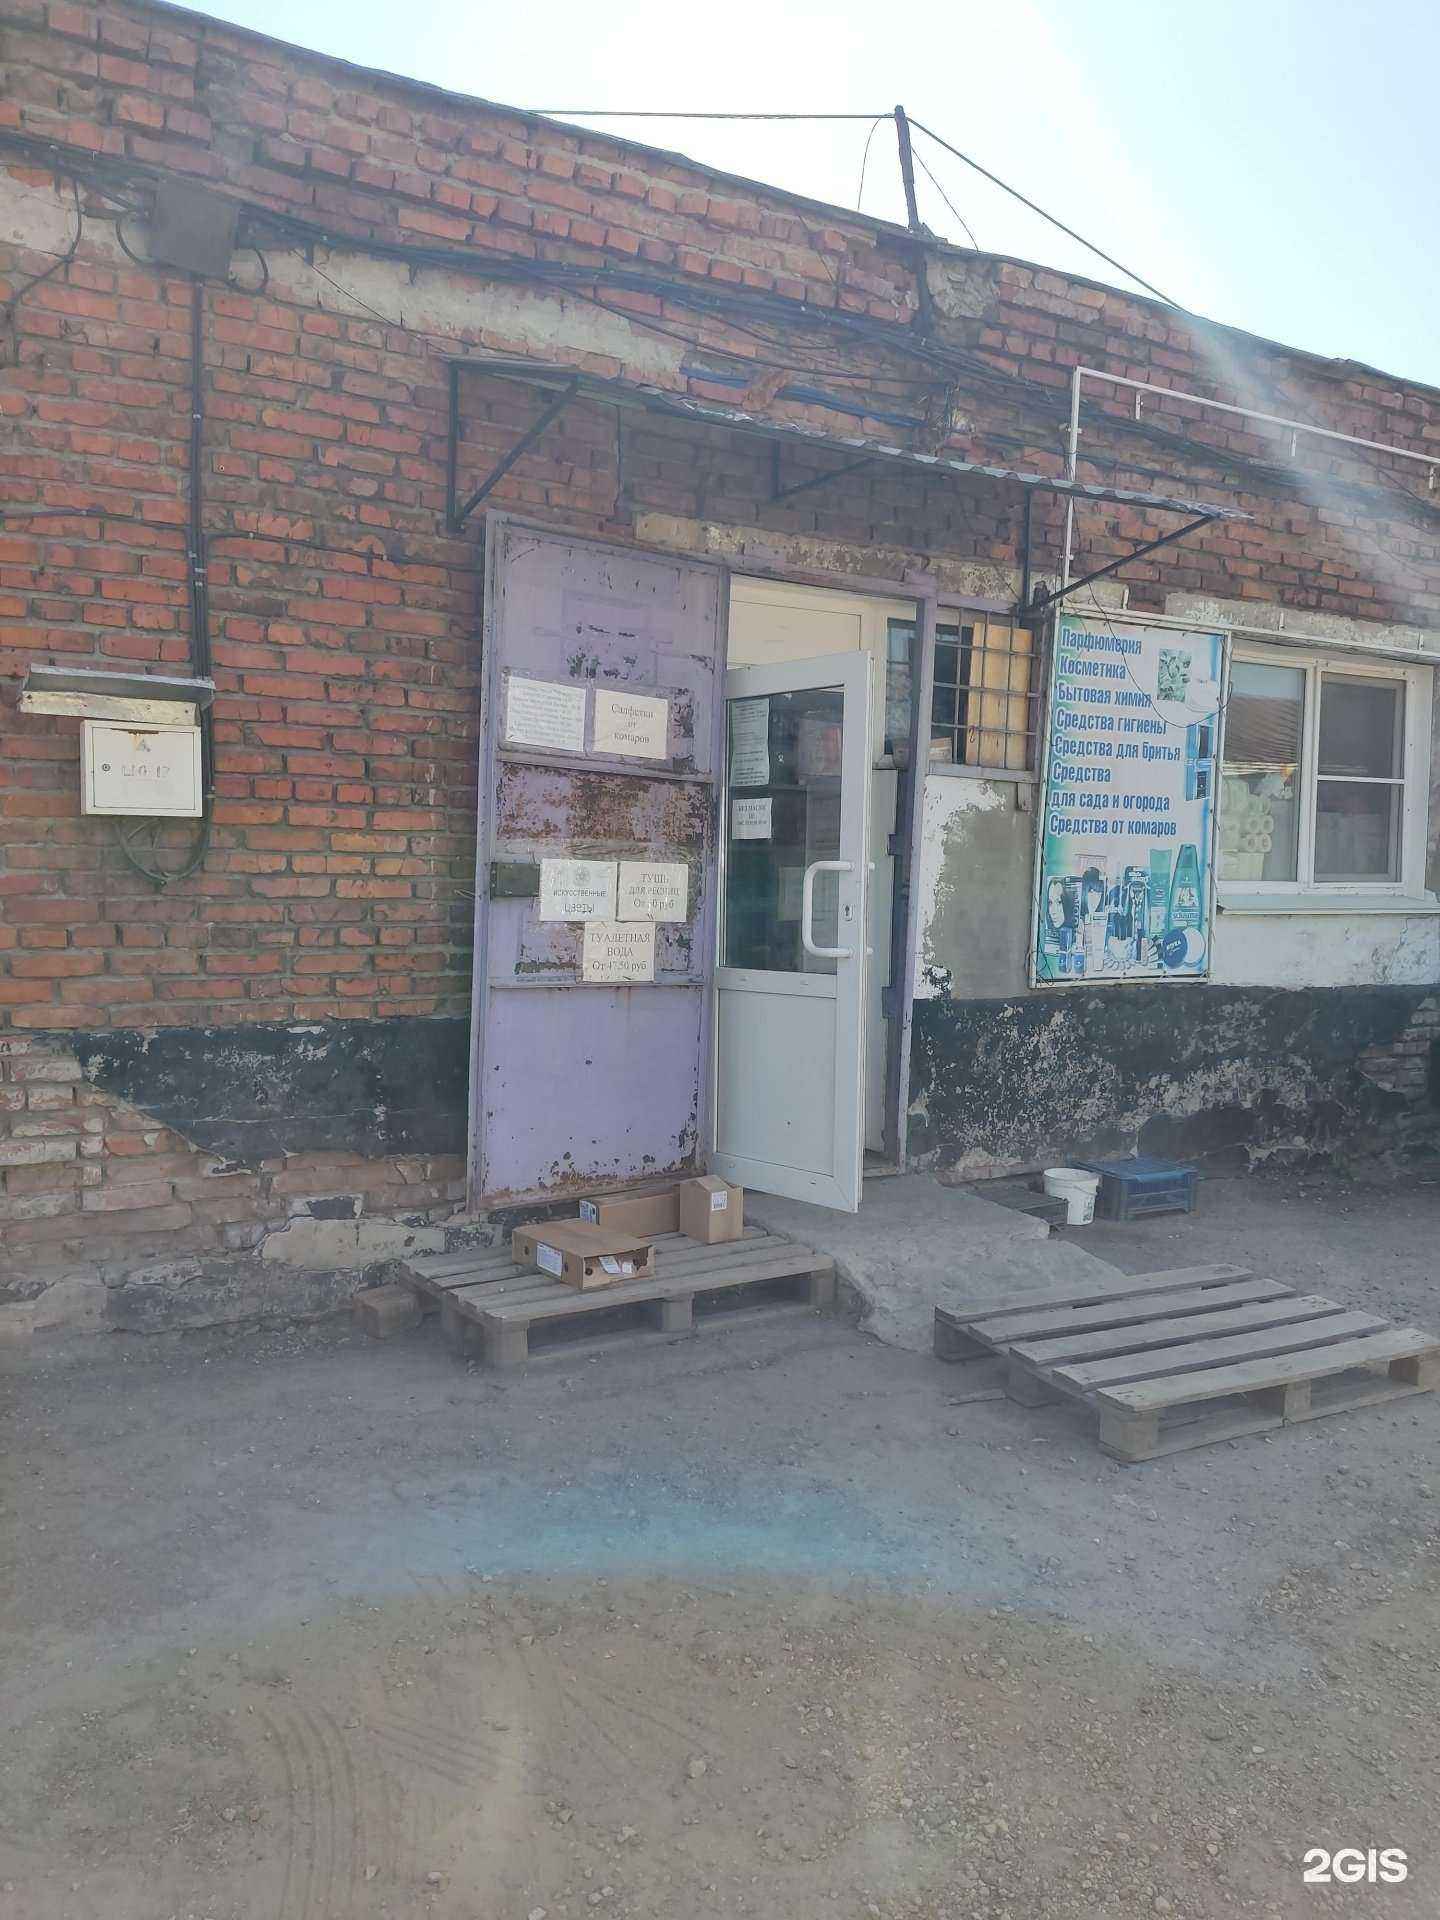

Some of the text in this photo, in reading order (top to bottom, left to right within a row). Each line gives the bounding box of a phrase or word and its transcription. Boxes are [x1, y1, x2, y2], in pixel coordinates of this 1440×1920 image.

[1062, 628, 1142, 655] Парфюмерия
[1060, 656, 1126, 679] Косметика
[1058, 683, 1152, 708] Бытовая химия
[1056, 709, 1167, 734] Средства гигиены
[1055, 736, 1181, 762] Средства для бритья
[1053, 762, 1111, 783] Средства
[1052, 792, 1170, 812] для сада и огорода
[1050, 814, 1177, 837] Средства от комаров
[607, 947, 634, 958] ВОДА
